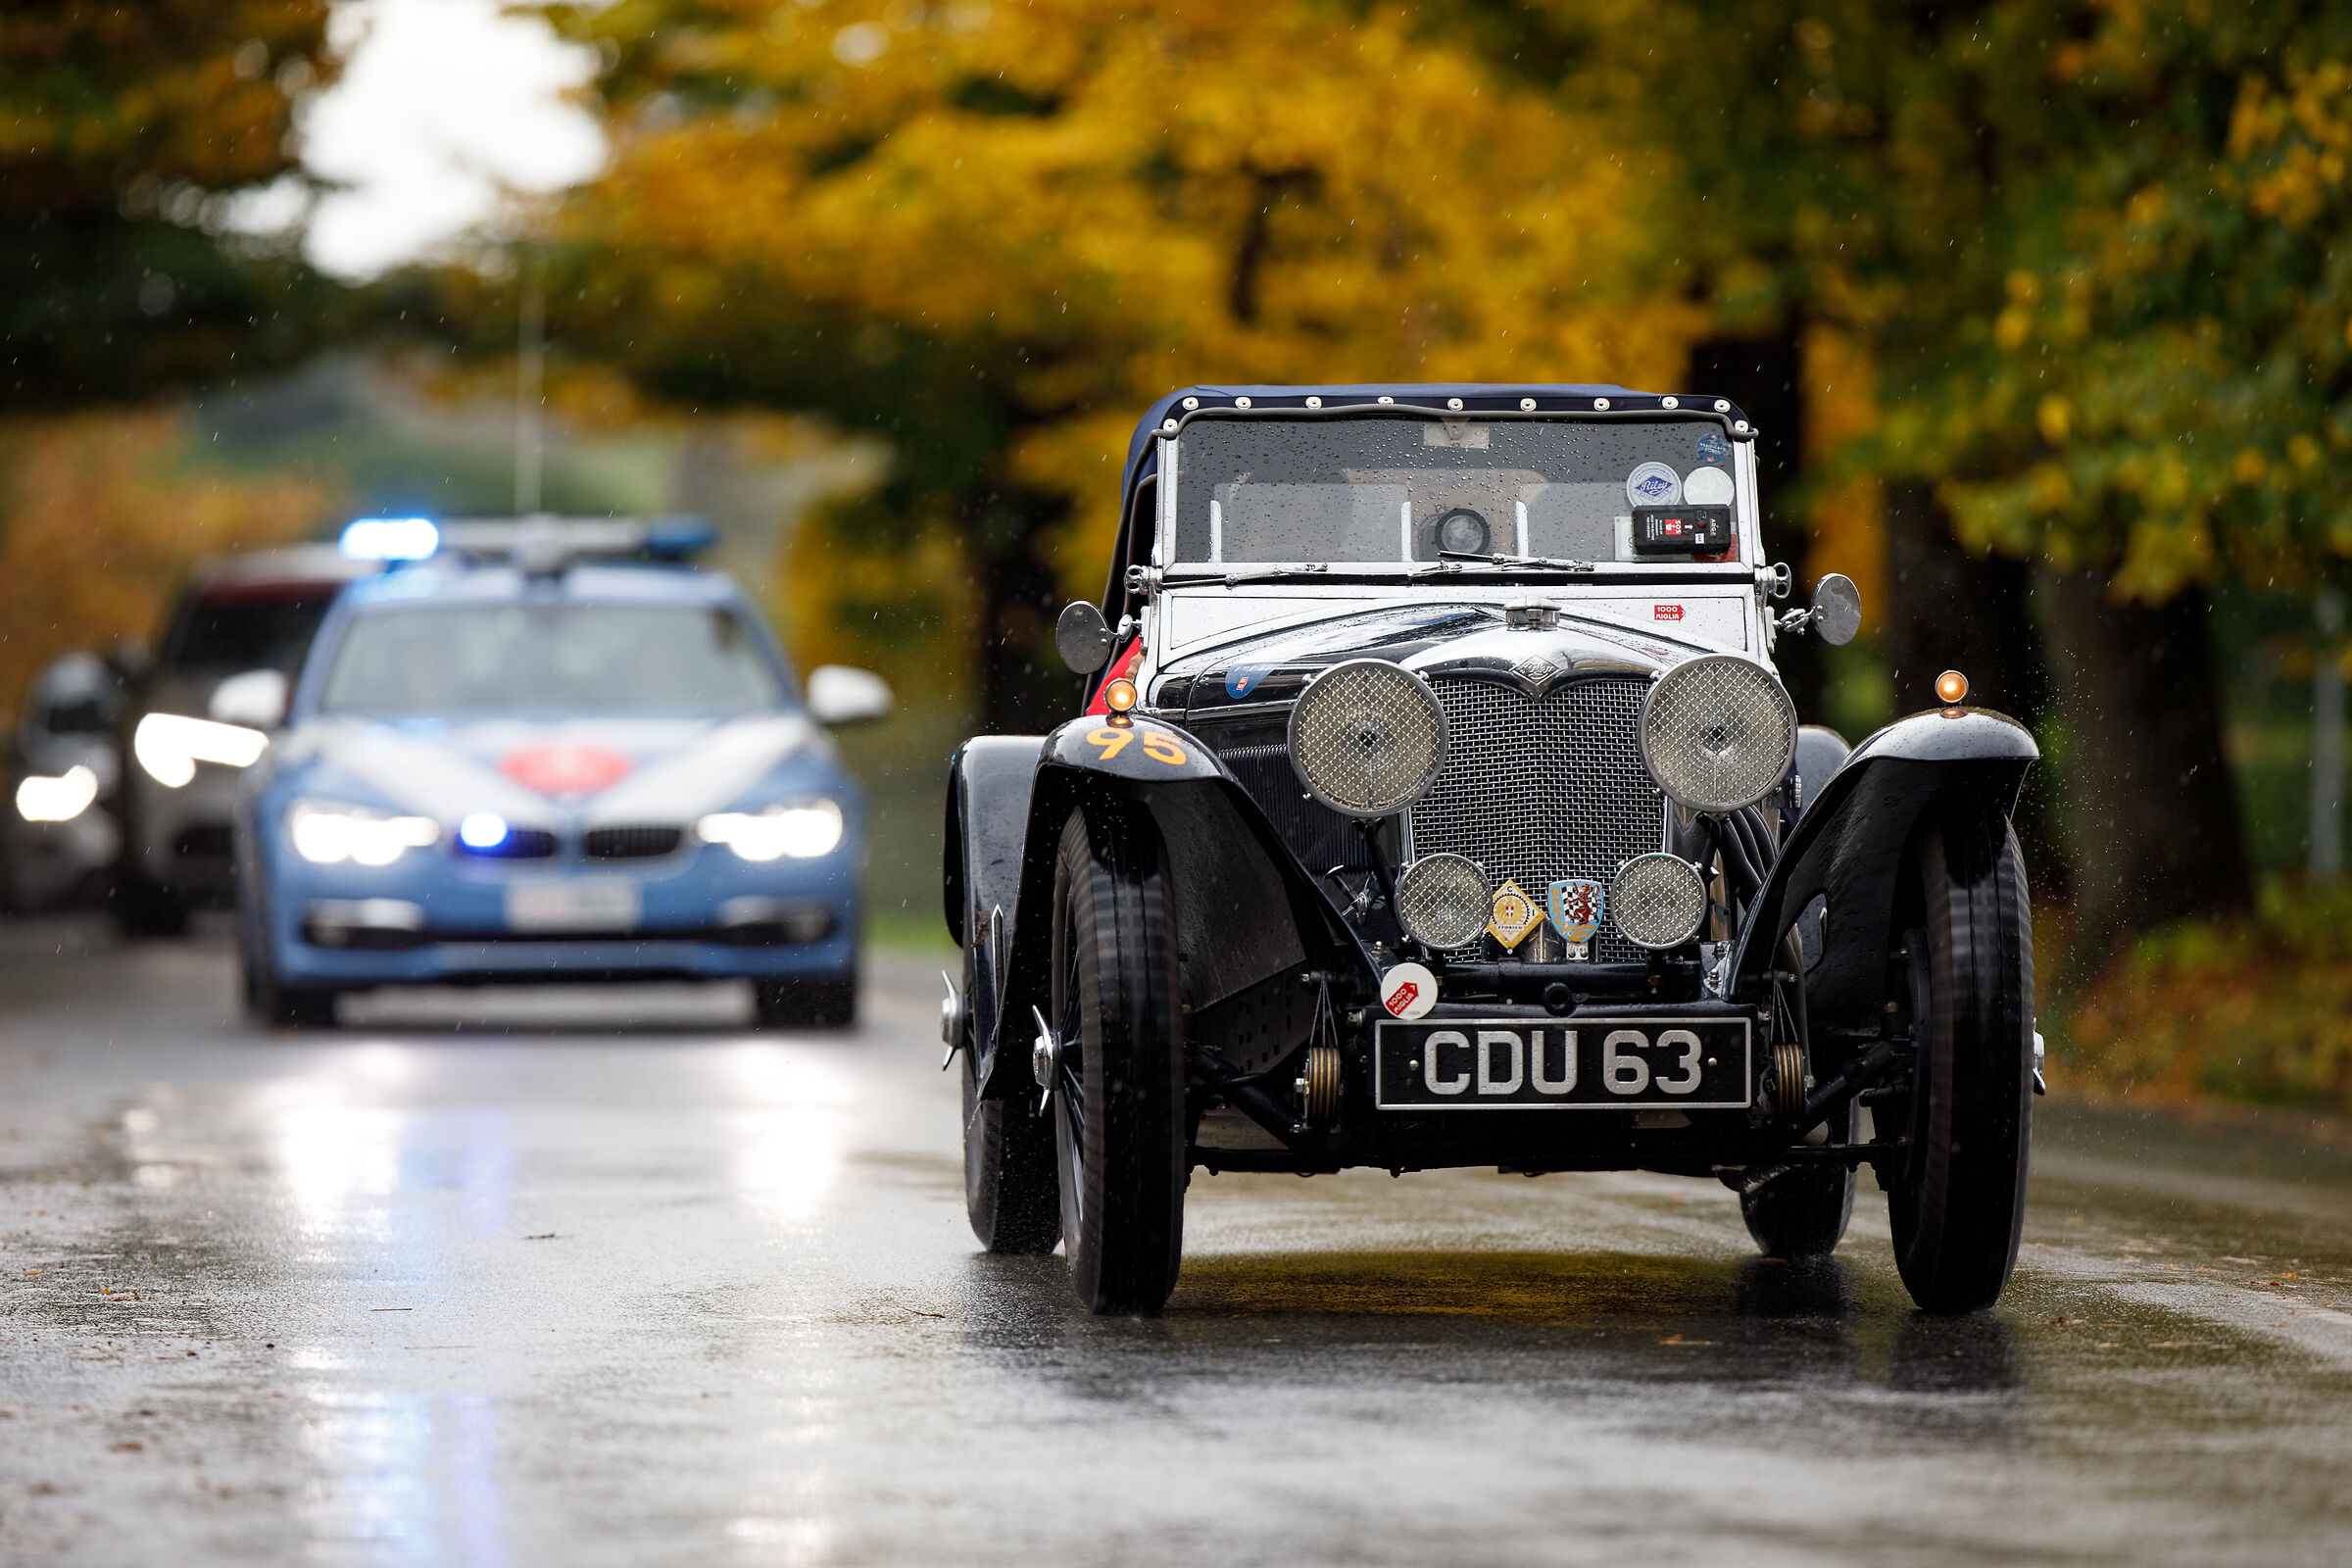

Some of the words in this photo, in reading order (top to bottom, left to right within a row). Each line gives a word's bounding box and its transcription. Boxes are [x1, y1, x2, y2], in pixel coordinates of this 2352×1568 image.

[1641, 480, 1668, 495] Riley
[1086, 727, 1188, 765] 95
[1551, 888, 1563, 925] BARC
[1389, 988, 1407, 1006] 1000
[1394, 992, 1414, 1013] MIGLIA
[1423, 1029, 1578, 1096] CDU
[1602, 1029, 1702, 1095] 63
